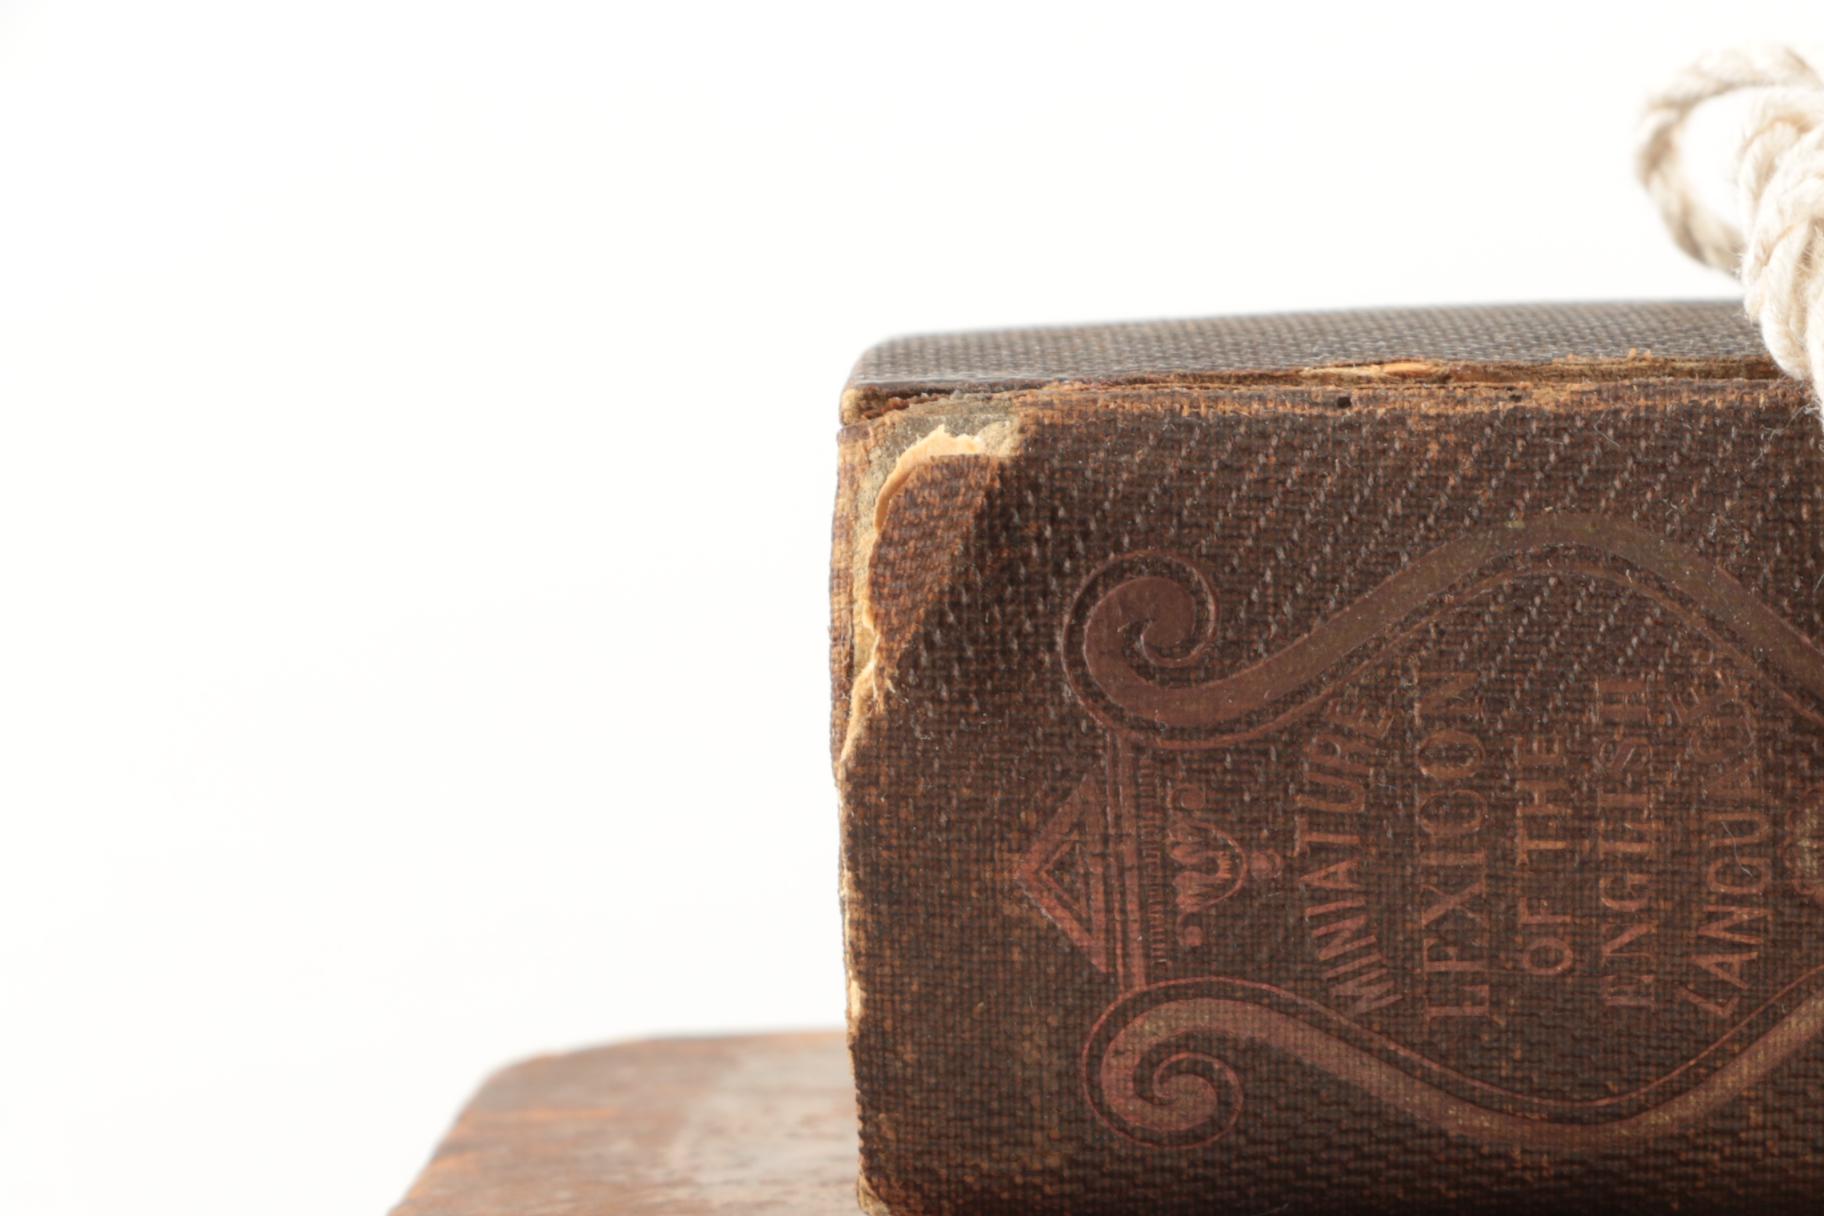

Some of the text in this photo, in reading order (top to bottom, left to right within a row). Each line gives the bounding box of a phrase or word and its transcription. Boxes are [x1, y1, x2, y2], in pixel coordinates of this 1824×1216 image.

[1415, 665, 1494, 1024] LEXICON
[1517, 734, 1573, 977] OF THE
[1598, 672, 1658, 1009] ENGLISH
[1674, 662, 1774, 1020] LANGUAGE
